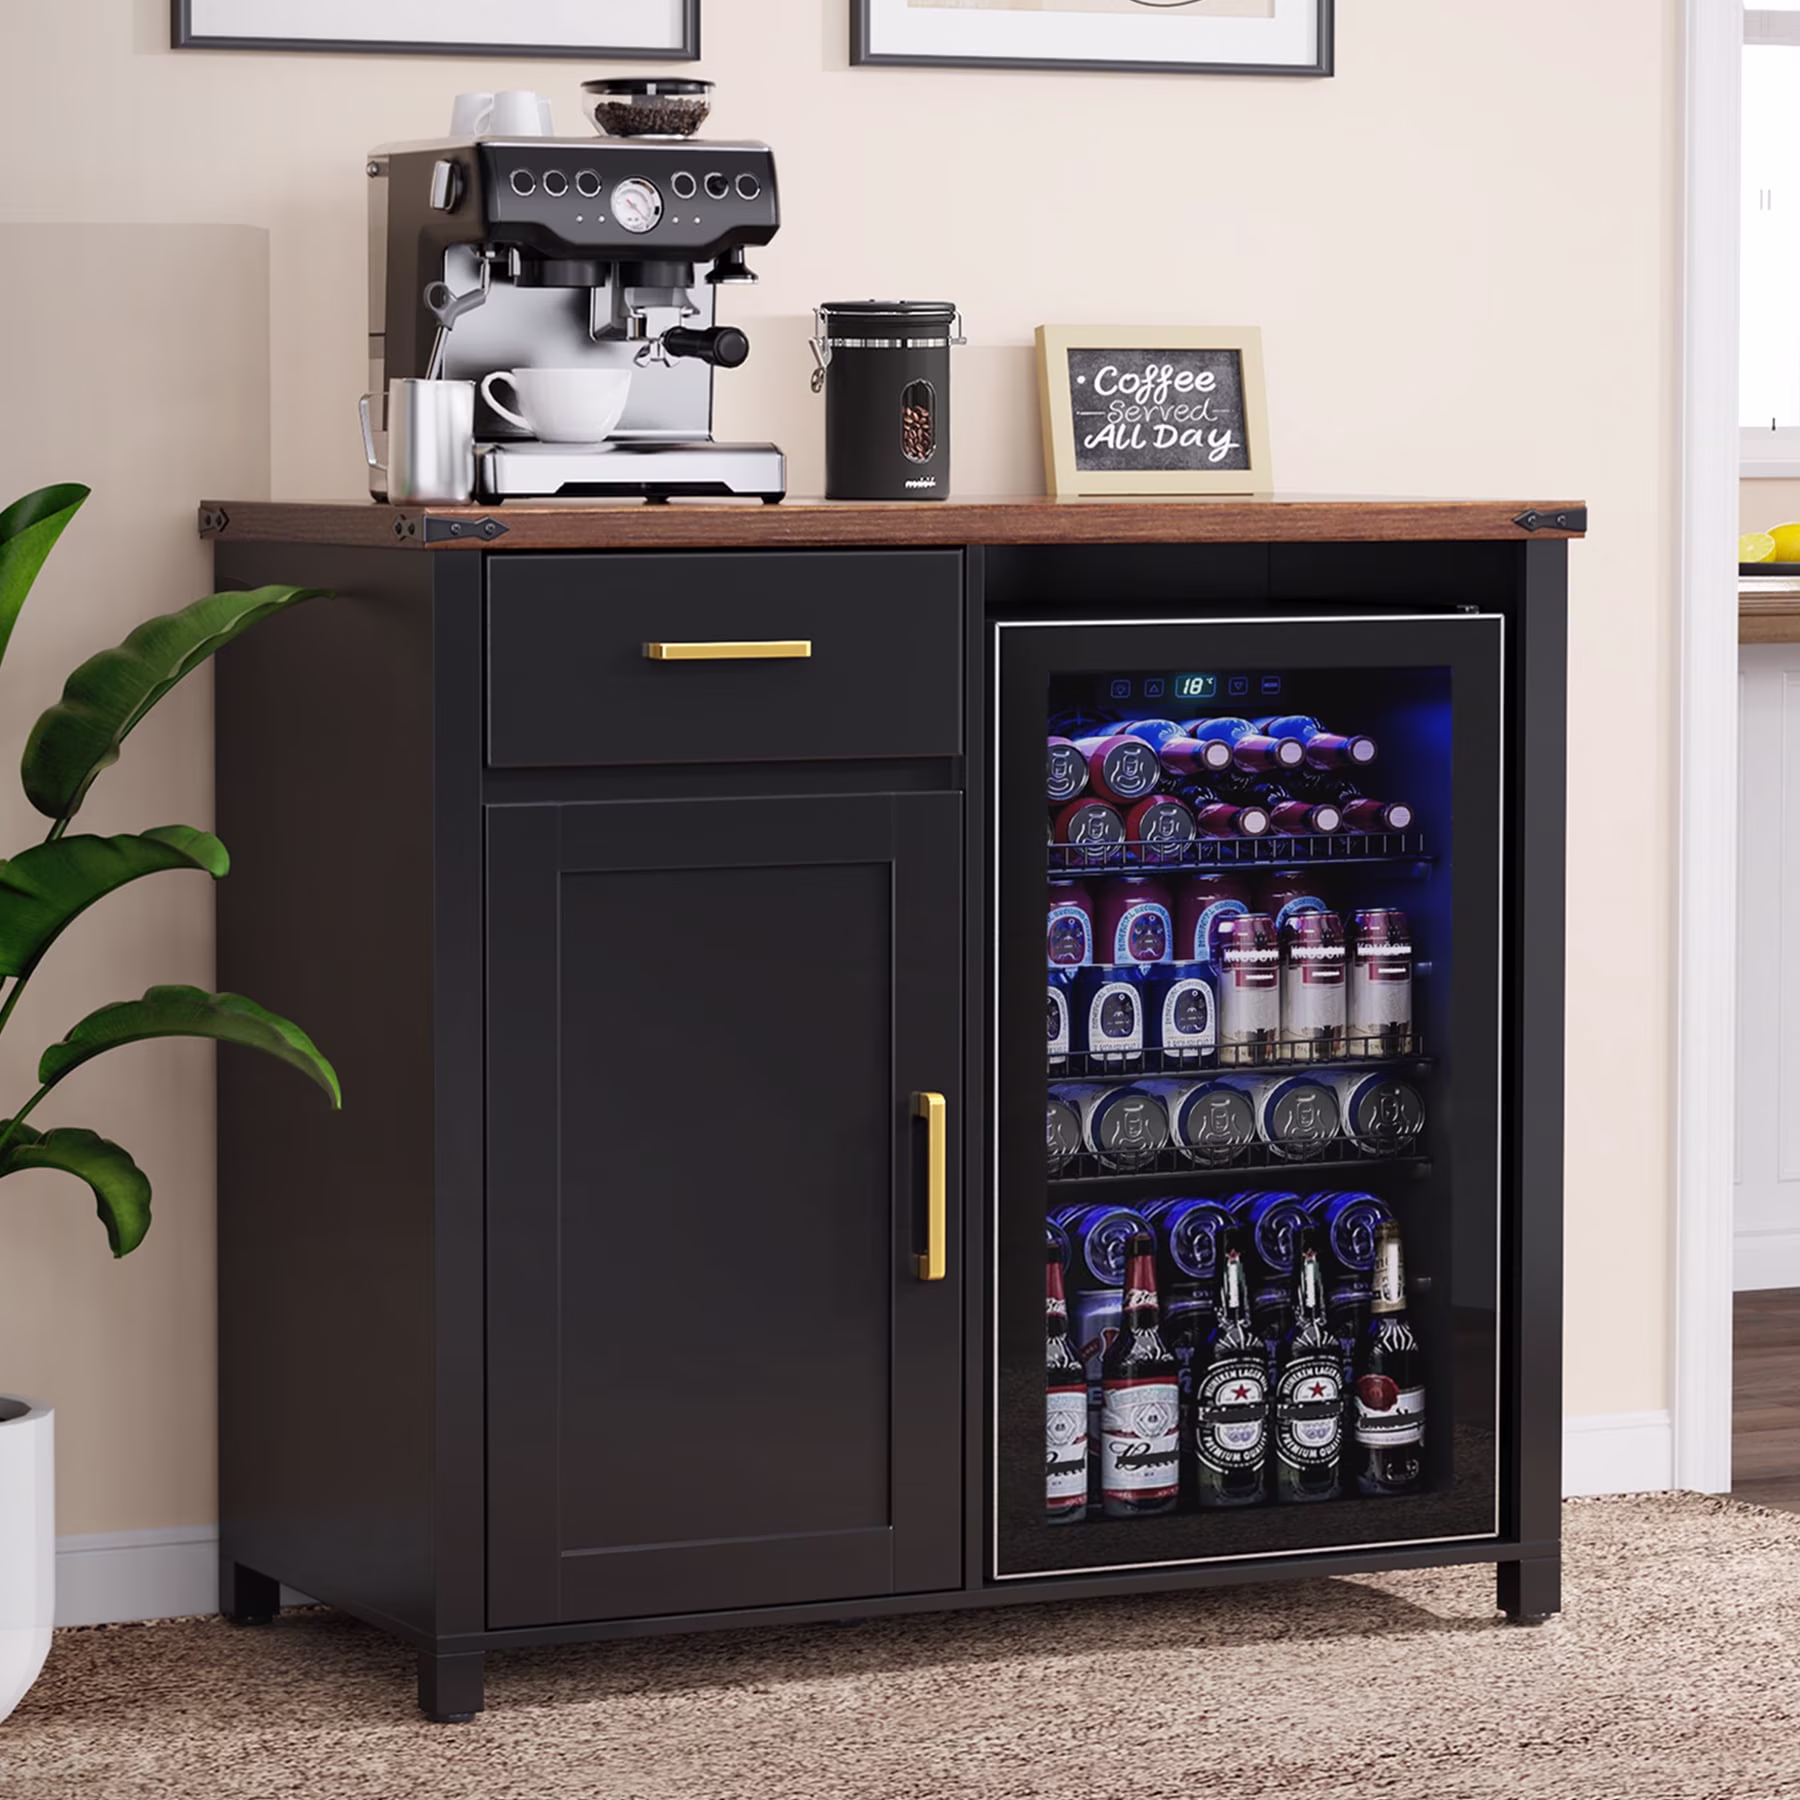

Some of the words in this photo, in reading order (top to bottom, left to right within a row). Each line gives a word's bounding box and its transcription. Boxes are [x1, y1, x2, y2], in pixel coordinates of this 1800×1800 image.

[1094, 364, 1216, 404] Coffee
[1107, 398, 1218, 424] Served
[1084, 423, 1147, 450] All
[1153, 424, 1240, 462] Day
